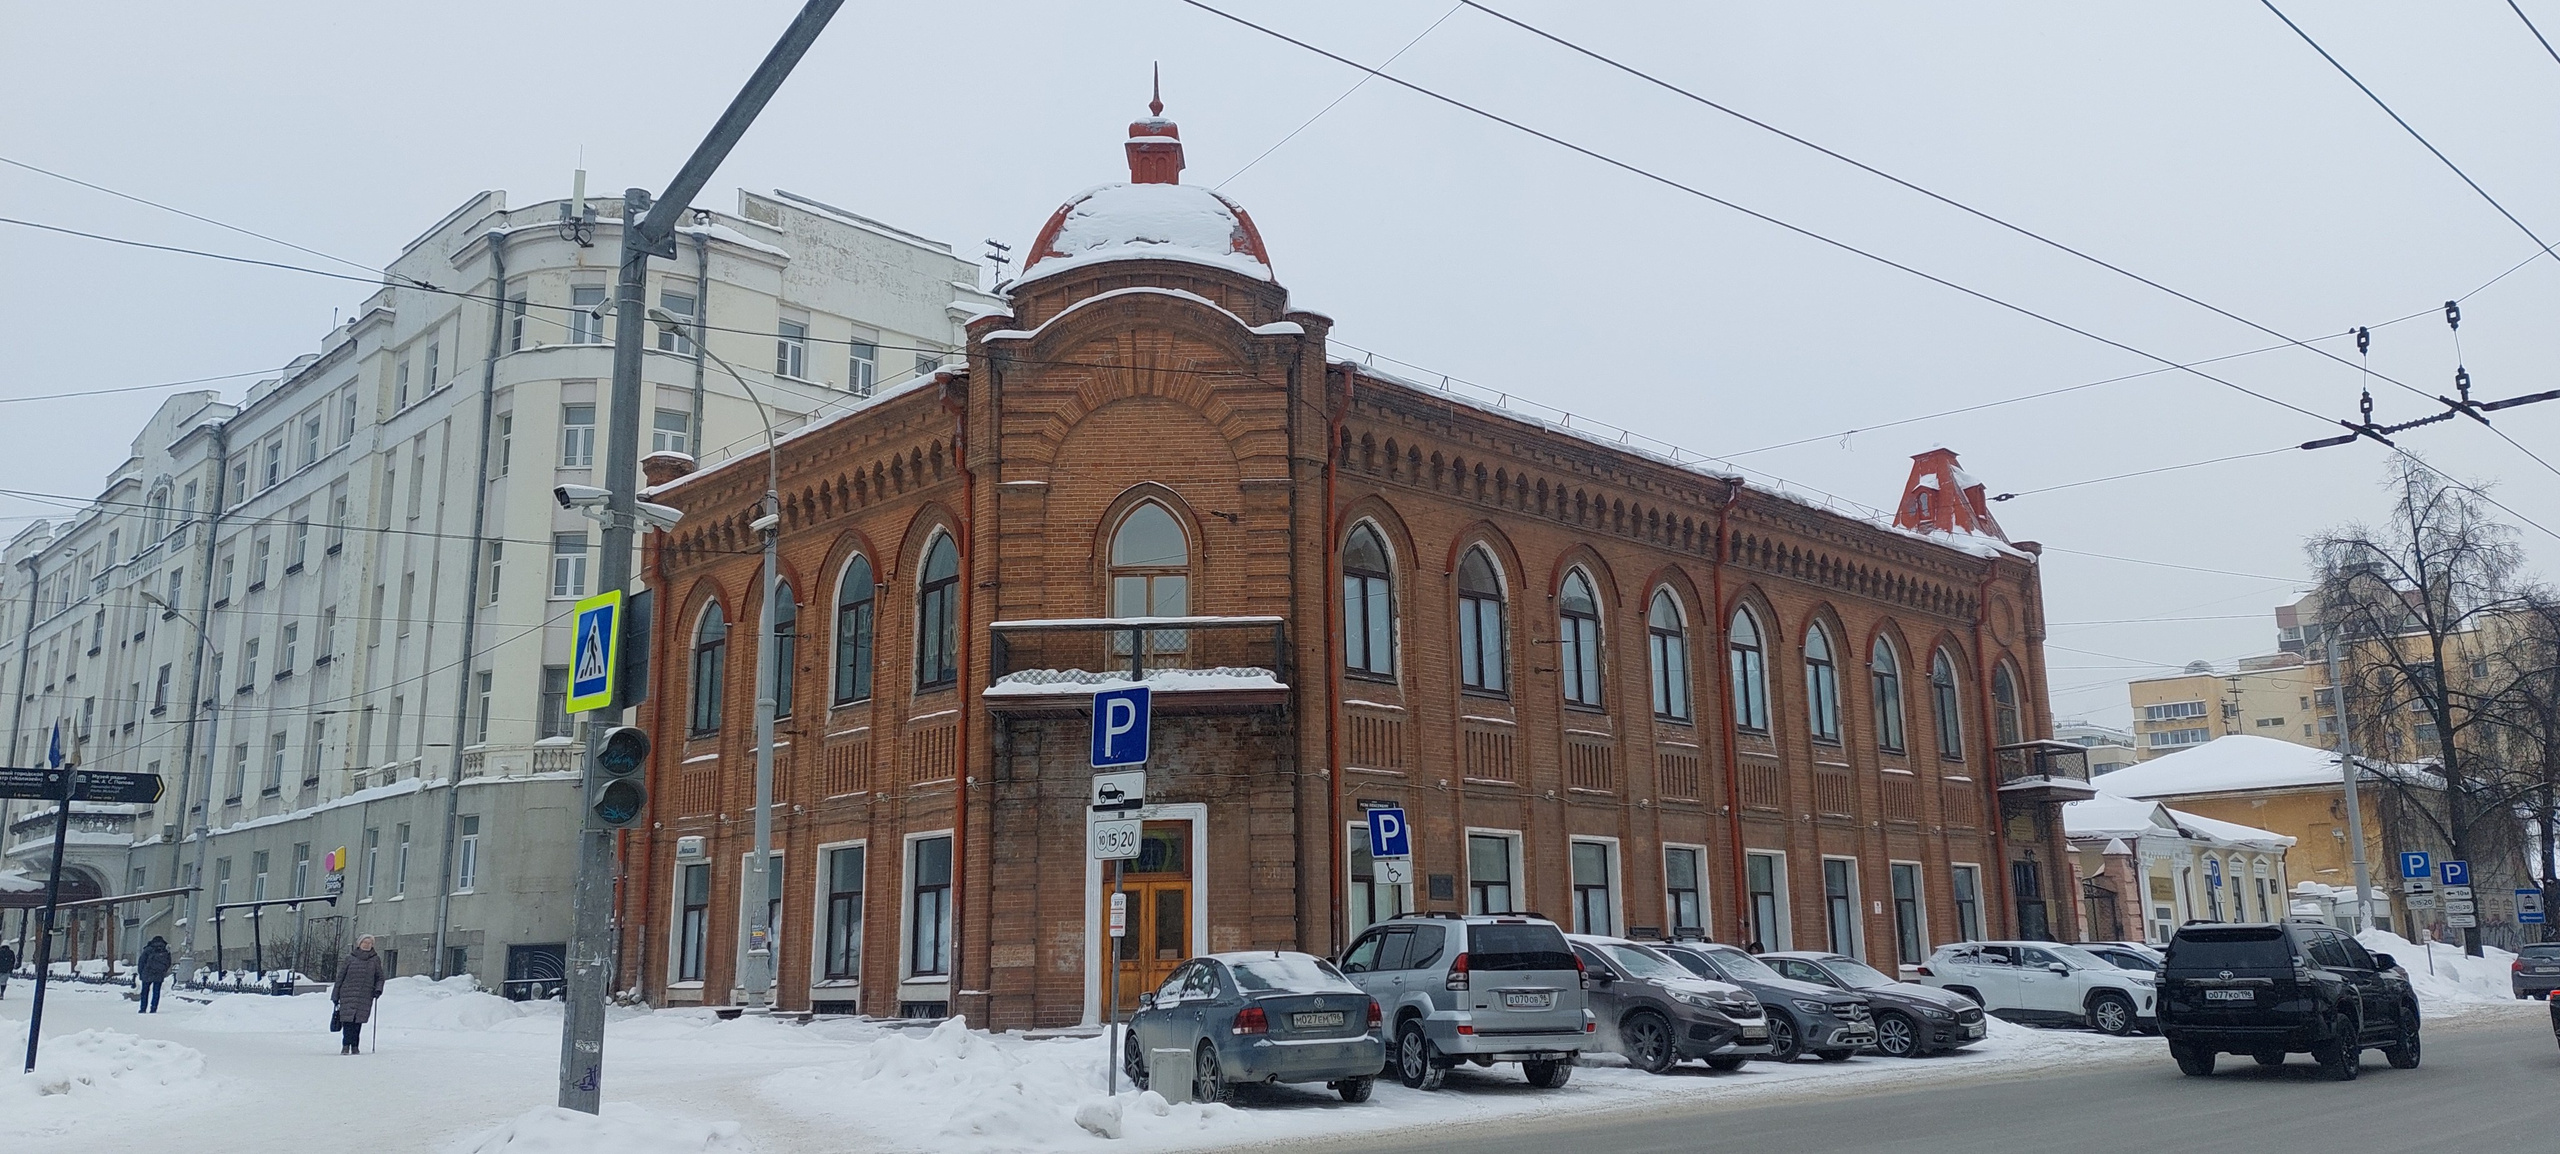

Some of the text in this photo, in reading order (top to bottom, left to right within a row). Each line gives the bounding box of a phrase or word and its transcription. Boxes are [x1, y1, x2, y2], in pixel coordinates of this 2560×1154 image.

[1104, 697, 1136, 758] P
[1098, 831, 1135, 847] 10 15 20
[1378, 814, 1400, 851] P
[2408, 854, 2425, 876] P
[2445, 863, 2462, 883] P
